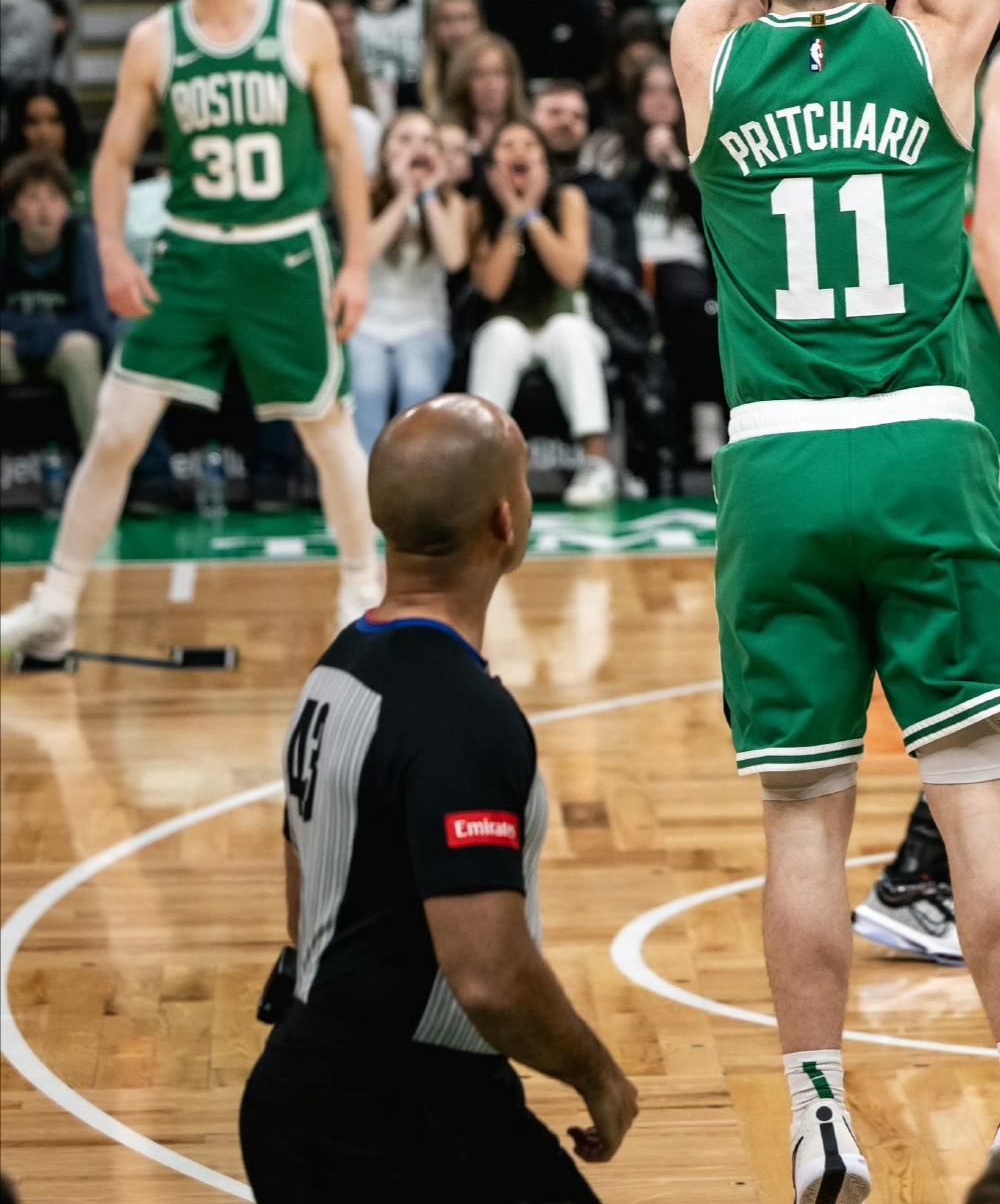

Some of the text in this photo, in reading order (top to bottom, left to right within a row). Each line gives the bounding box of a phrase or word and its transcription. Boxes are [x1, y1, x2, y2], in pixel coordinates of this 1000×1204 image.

[172, 71, 288, 134] BOSTON
[192, 132, 283, 201] 30
[719, 100, 930, 177] PRITCHARD
[770, 173, 906, 320] 11
[454, 817, 516, 840] Emirates
